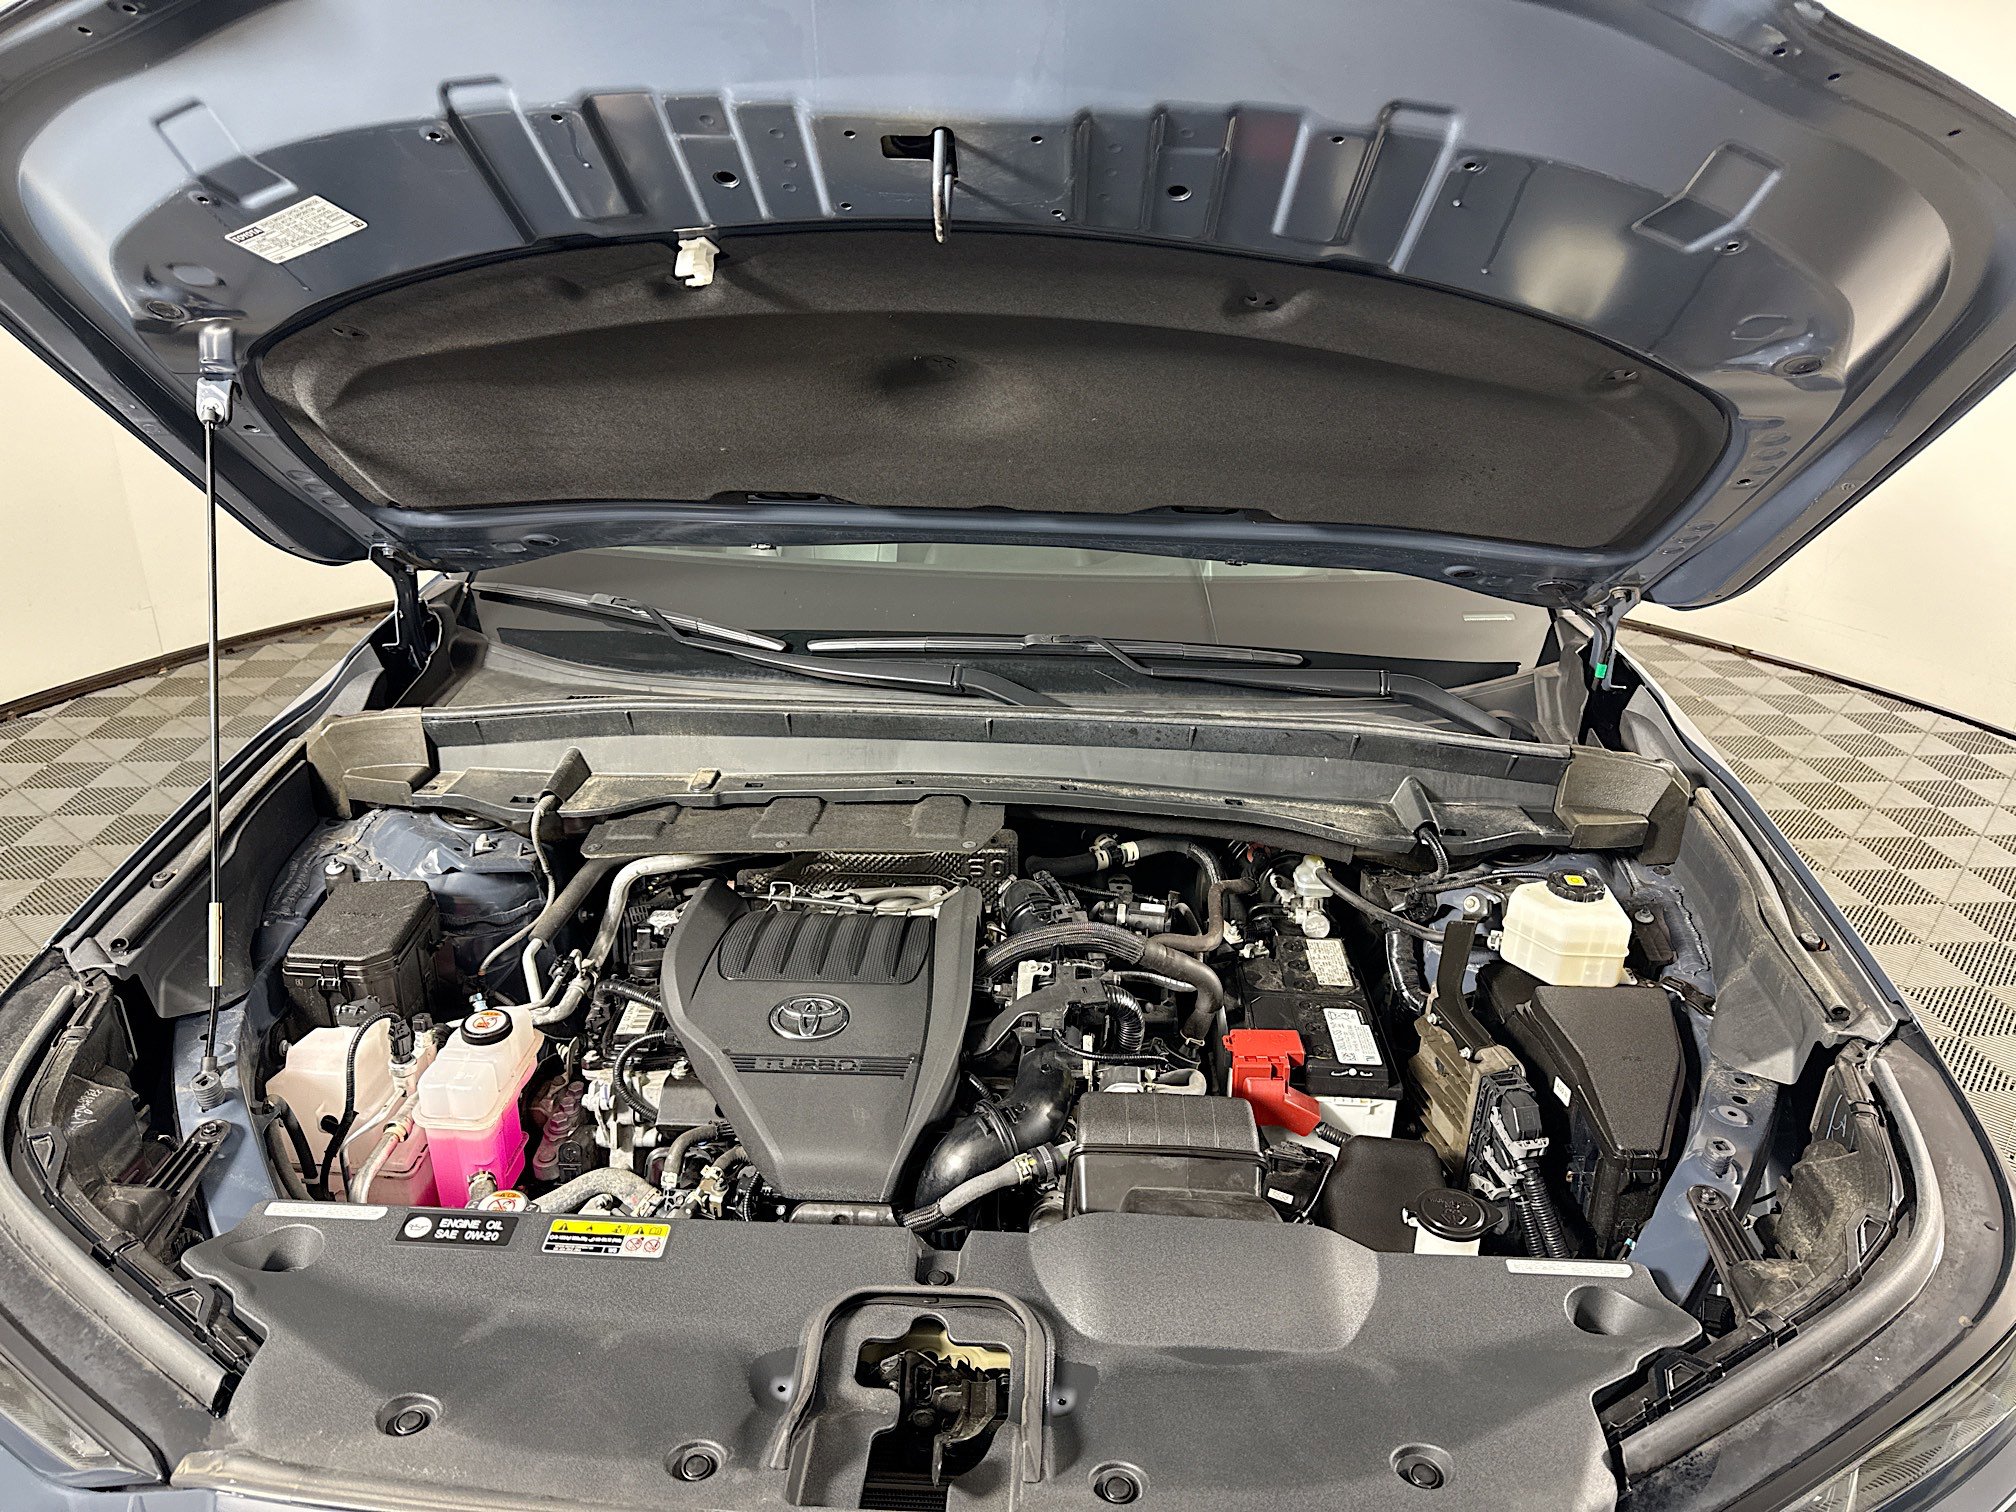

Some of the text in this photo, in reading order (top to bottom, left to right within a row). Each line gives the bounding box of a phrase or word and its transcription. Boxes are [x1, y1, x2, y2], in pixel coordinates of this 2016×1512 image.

[231, 227, 263, 242] TOYOTA
[757, 1057, 860, 1072] TURBO
[439, 1218, 504, 1230] ENGINE OIL
[434, 1229, 500, 1241] SAE 0W-20
